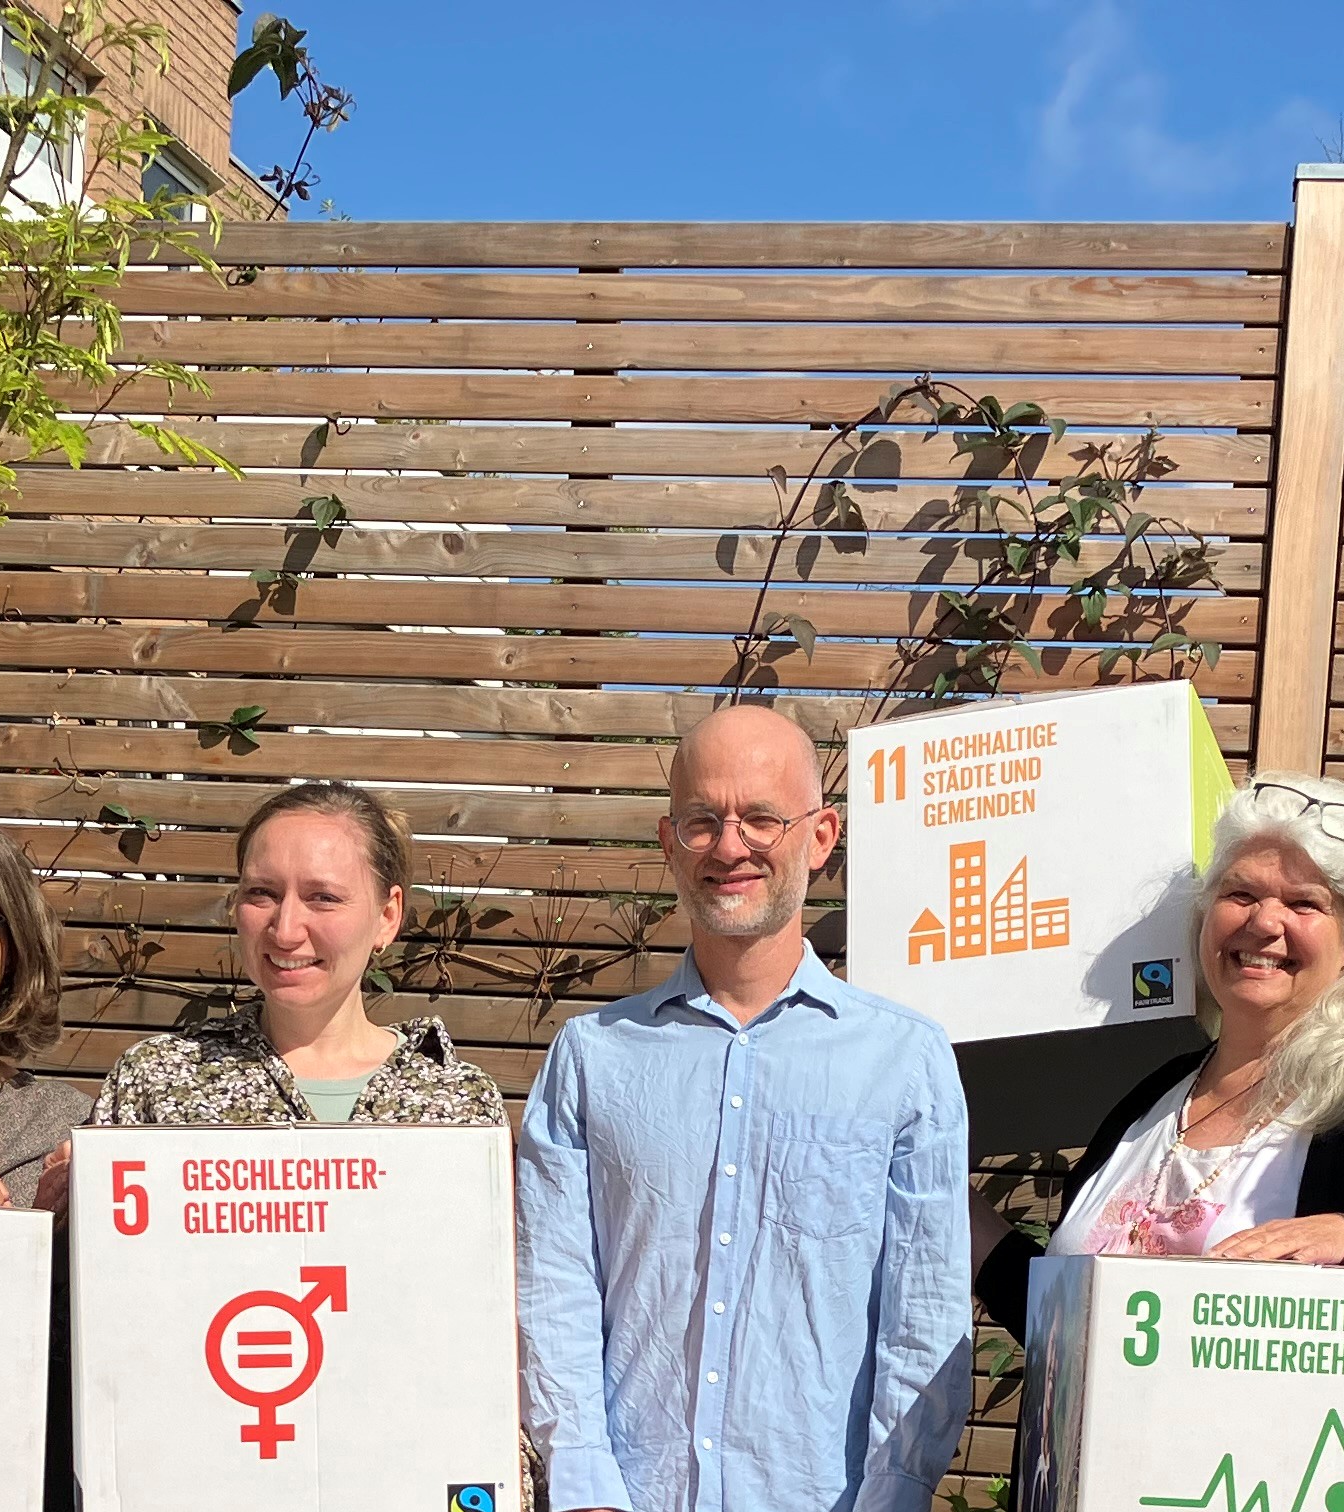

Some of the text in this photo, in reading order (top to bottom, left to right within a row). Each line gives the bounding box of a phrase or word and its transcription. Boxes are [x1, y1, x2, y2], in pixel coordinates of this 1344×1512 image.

[923, 722, 1057, 765] NACHHALTIGE
[867, 745, 906, 804] 11
[923, 756, 1041, 797] STÄDTE UND
[923, 789, 1036, 827] GEMEINDEN
[183, 1158, 386, 1191] GESCHLECHTER-
[112, 1161, 149, 1235] 5
[184, 1201, 328, 1233] GLEICHHEIT
[1123, 1291, 1161, 1366] 3
